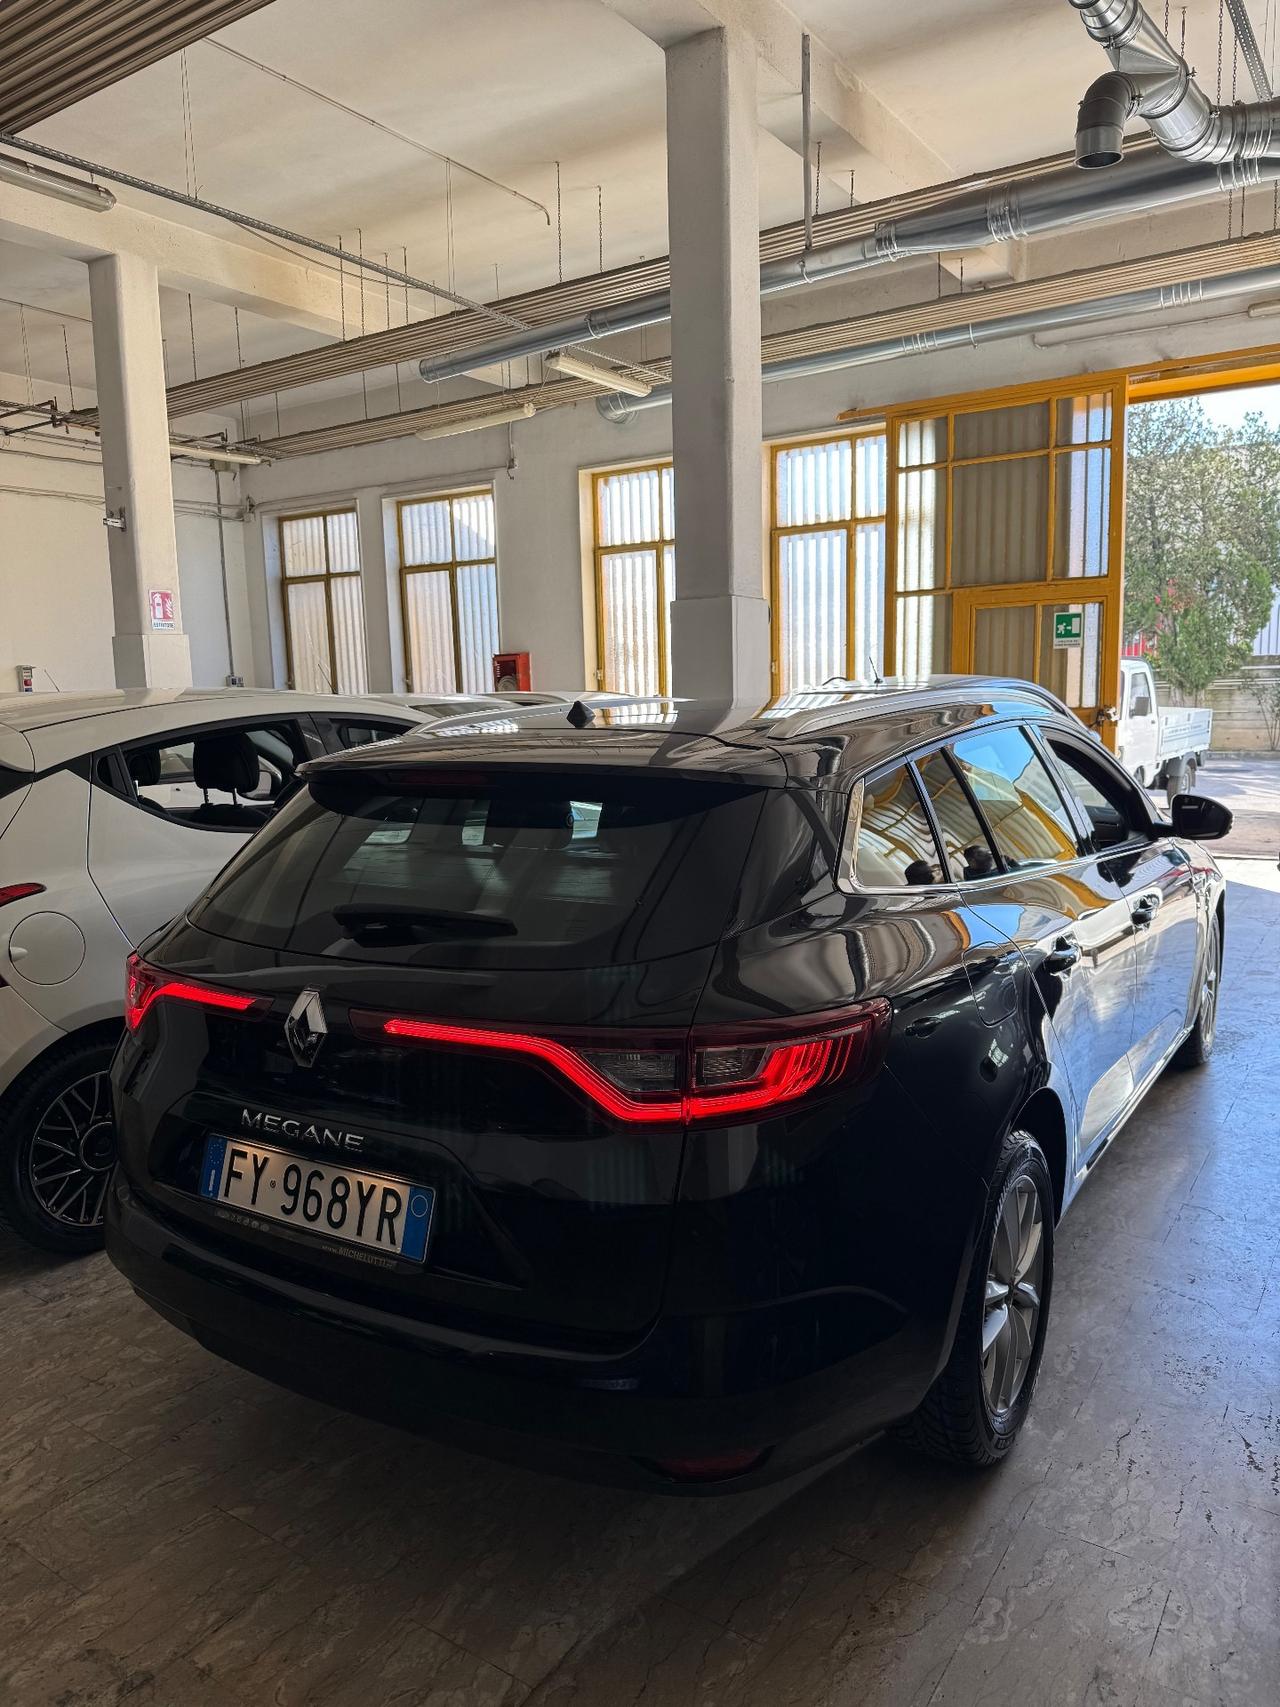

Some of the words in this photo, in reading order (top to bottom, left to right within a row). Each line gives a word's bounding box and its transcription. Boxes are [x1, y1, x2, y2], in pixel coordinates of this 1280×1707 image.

[241, 1108, 364, 1152] MEGANE
[223, 1147, 269, 1206] FY
[280, 1163, 403, 1246] 968YR
